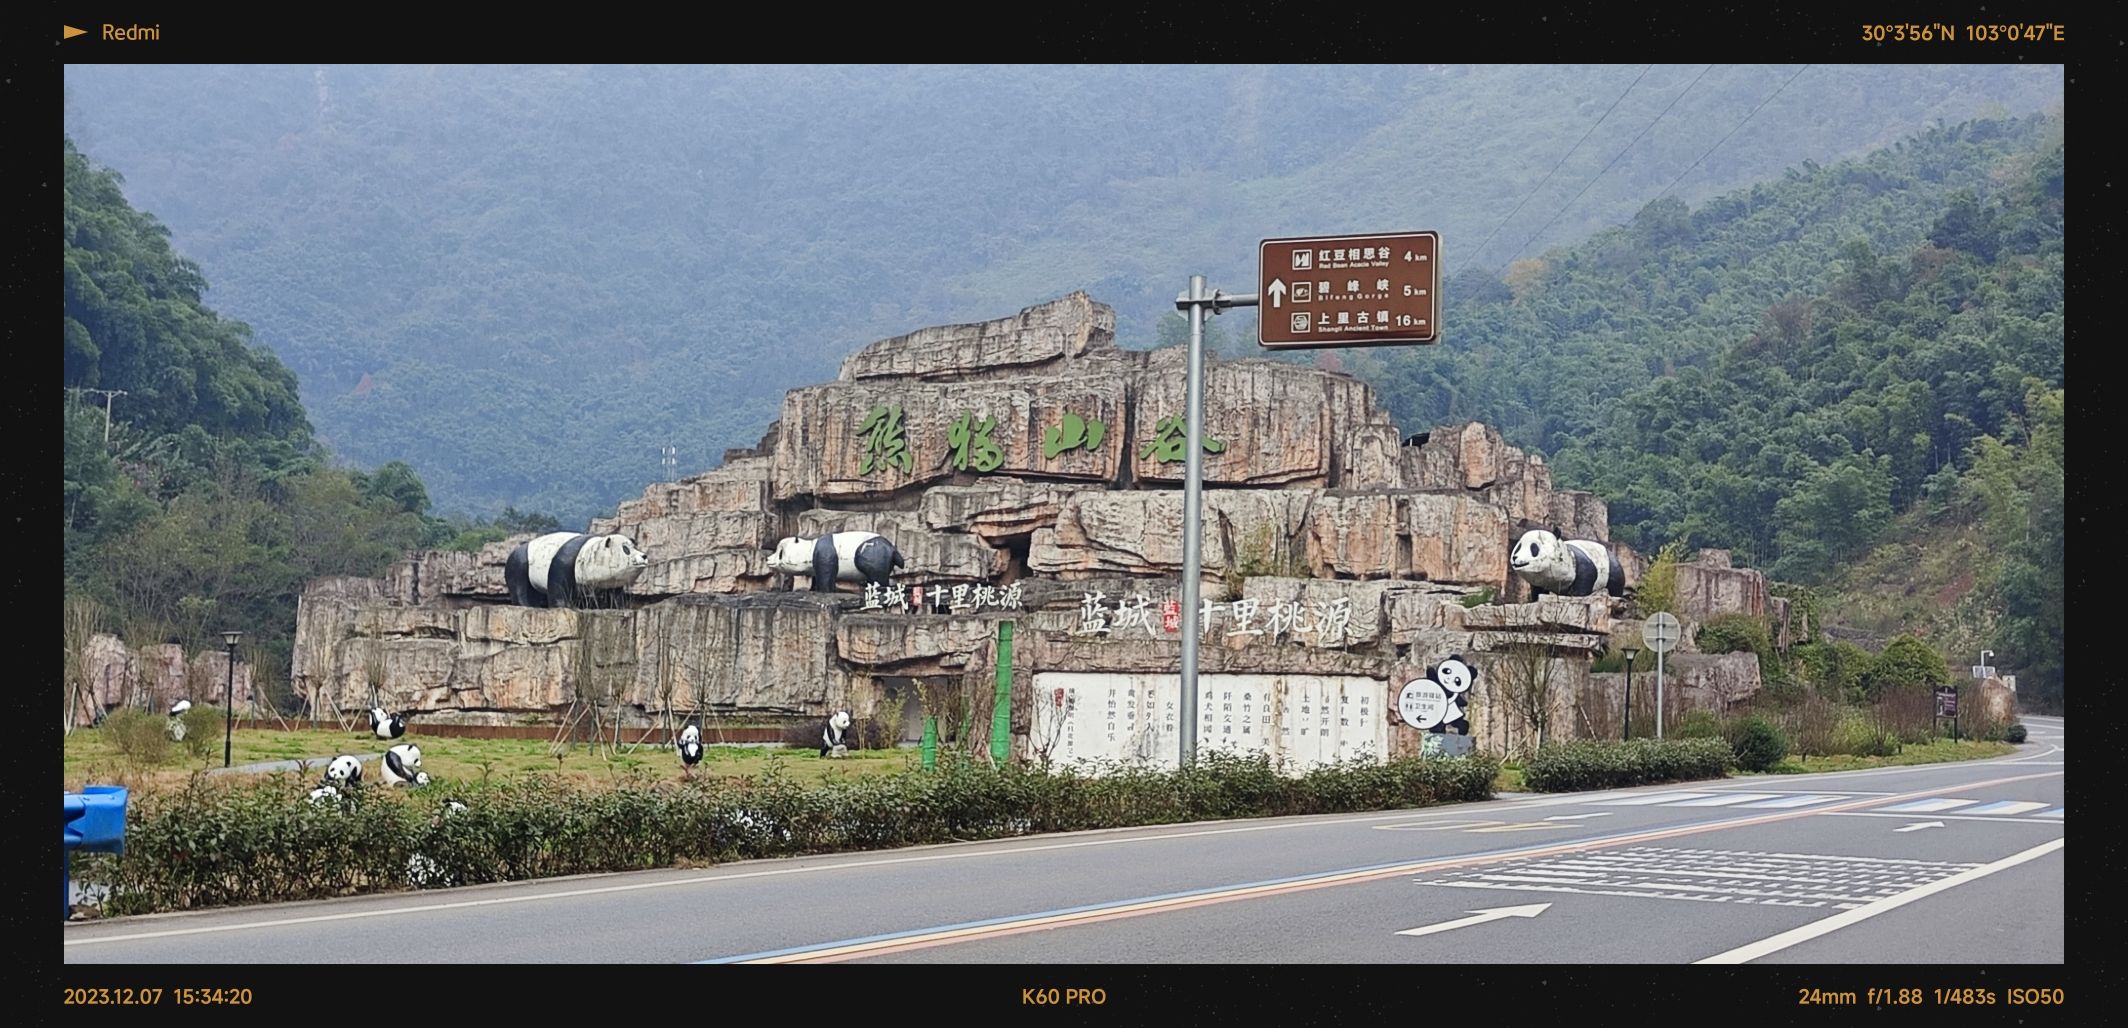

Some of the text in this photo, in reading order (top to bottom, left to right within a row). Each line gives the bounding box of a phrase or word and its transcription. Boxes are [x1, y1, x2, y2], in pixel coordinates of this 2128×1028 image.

[1319, 247, 1428, 262] 红豆相思谷 4 km
[1333, 261, 1348, 269] Bean
[1349, 260, 1370, 268] Acacia
[1371, 260, 1390, 268] Valley
[1318, 279, 1427, 296] 碧峰峡 5 km
[1356, 292, 1389, 300] Gorge
[1318, 310, 1390, 325] 上里古镇
[1396, 314, 1412, 326] 16
[1344, 325, 1370, 333] Ancient
[856, 403, 1228, 476] 熊猫山谷
[860, 581, 909, 614] 蓝城
[925, 581, 1024, 611] 十里桃源
[1074, 592, 1352, 648] 蓝城 十里桃源
